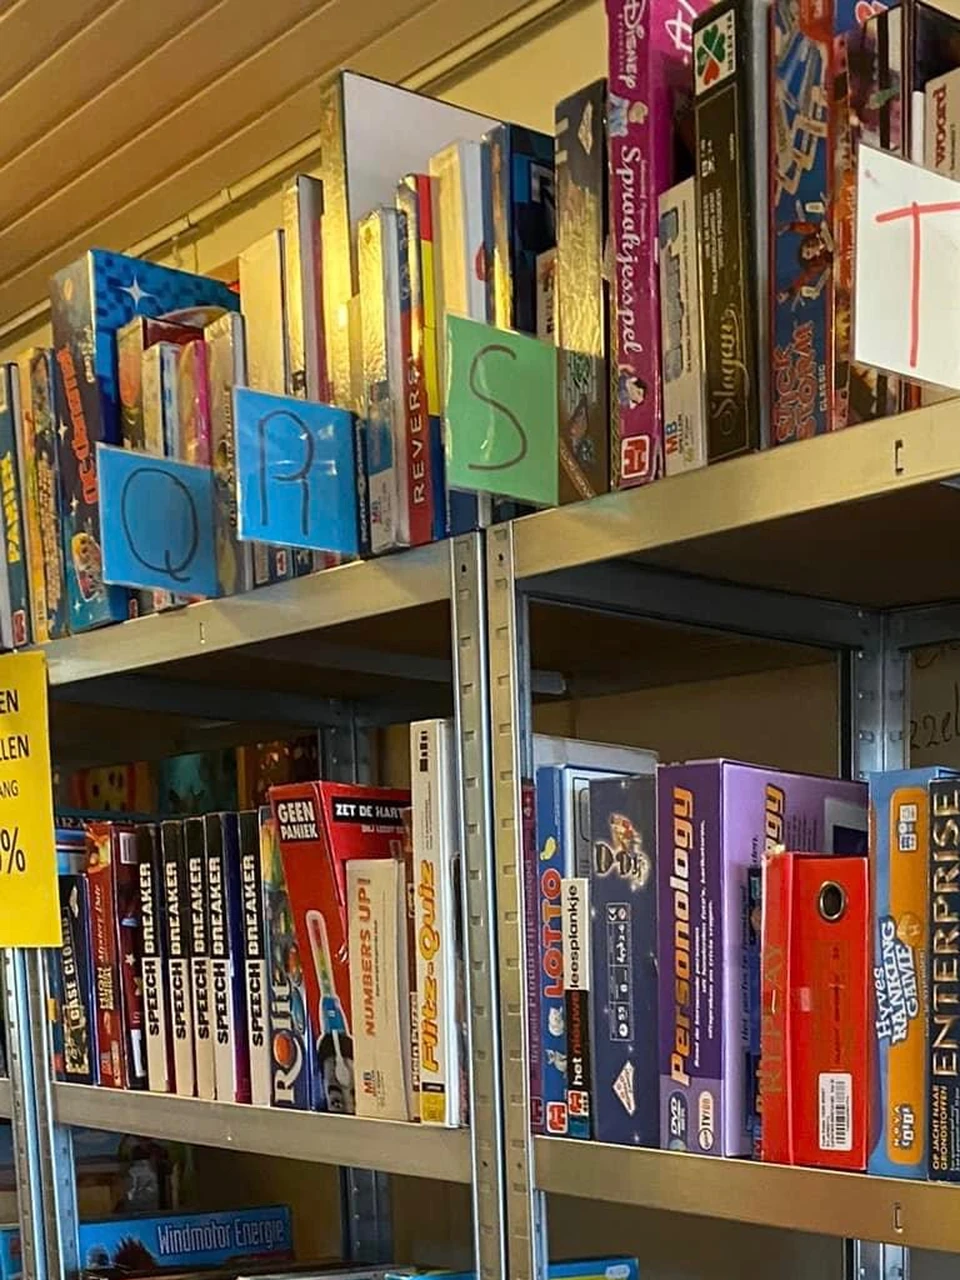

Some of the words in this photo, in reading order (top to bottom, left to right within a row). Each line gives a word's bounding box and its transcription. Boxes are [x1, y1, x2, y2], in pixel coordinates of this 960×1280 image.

[467, 344, 528, 471] S
[258, 409, 316, 537] R
[121, 467, 198, 582] Q
[278, 800, 316, 824] GEEN
[280, 823, 320, 841] PANIEK
[335, 803, 357, 819] ZET
[358, 803, 374, 818] DE
[358, 877, 372, 921] UP!
[541, 867, 564, 998] LOTTO
[568, 882, 581, 989] leesplankje
[668, 786, 695, 1087] Personology
[933, 788, 960, 1079] ENTERPRISE
[65, 980, 80, 1021] CASE
[142, 958, 161, 1037] SPEECH
[169, 960, 188, 1040] SPEECH
[193, 957, 211, 1040] SPEECH
[213, 958, 231, 1045] SPEECH
[247, 958, 265, 1047] SPEECH
[364, 927, 377, 1037] NUMBERS
[418, 859, 440, 1074] Flitz-Quiz
[875, 965, 894, 1040] Hyves
[880, 919, 907, 1044] RANKING
[898, 944, 919, 1018] GAME
[569, 991, 582, 1052] nieuwe
[572, 1056, 584, 1086] het
[670, 1096, 680, 1136] DVD
[939, 1085, 949, 1171] GRONDSTOFFEN
[158, 1217, 230, 1255] Windmotor
[235, 1219, 285, 1248] Energie
